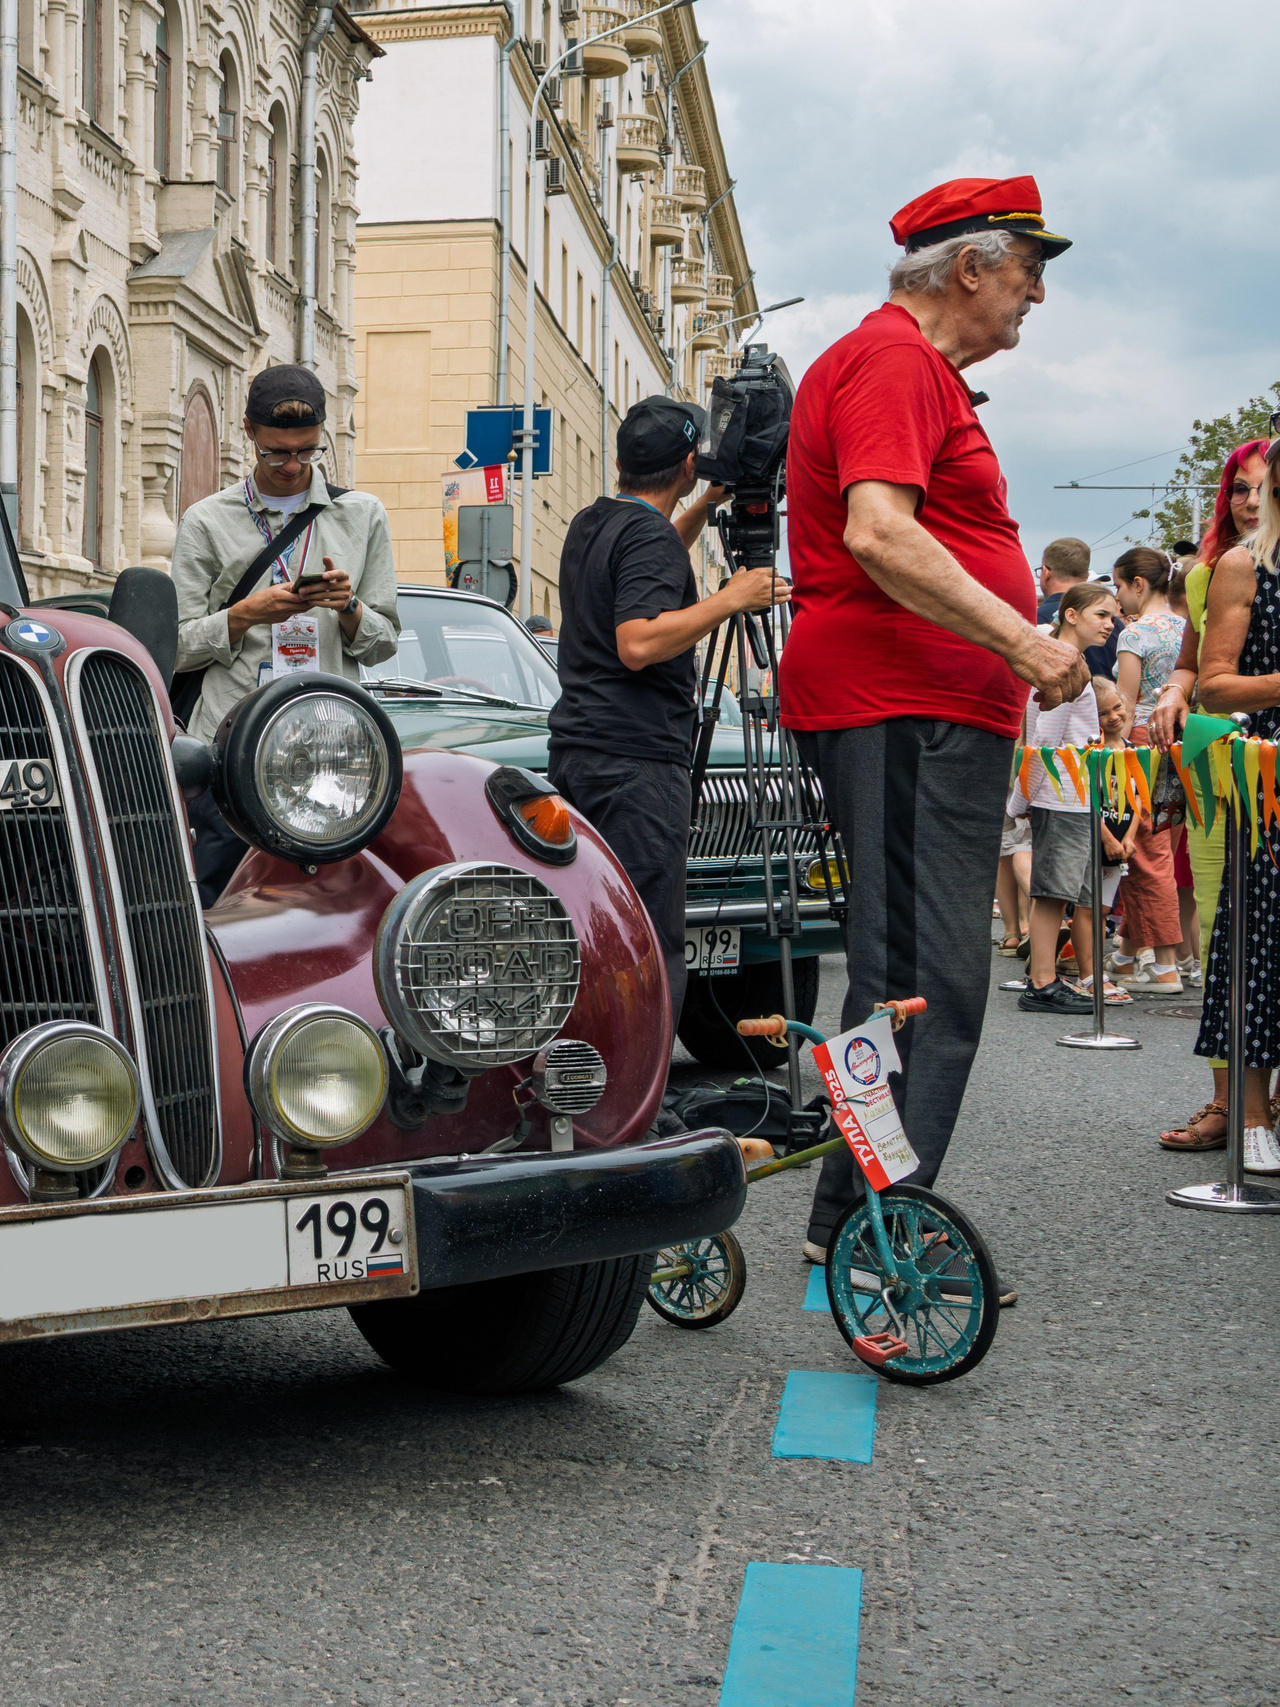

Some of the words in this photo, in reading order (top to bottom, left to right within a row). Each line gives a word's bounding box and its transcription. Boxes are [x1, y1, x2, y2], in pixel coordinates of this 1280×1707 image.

[448, 904, 547, 938] OFF
[421, 946, 574, 983] ROAD
[702, 955, 723, 965] RUS
[841, 1114, 874, 1167] ТУЛА
[294, 1197, 390, 1260] 199
[317, 1260, 364, 1283] RUS
